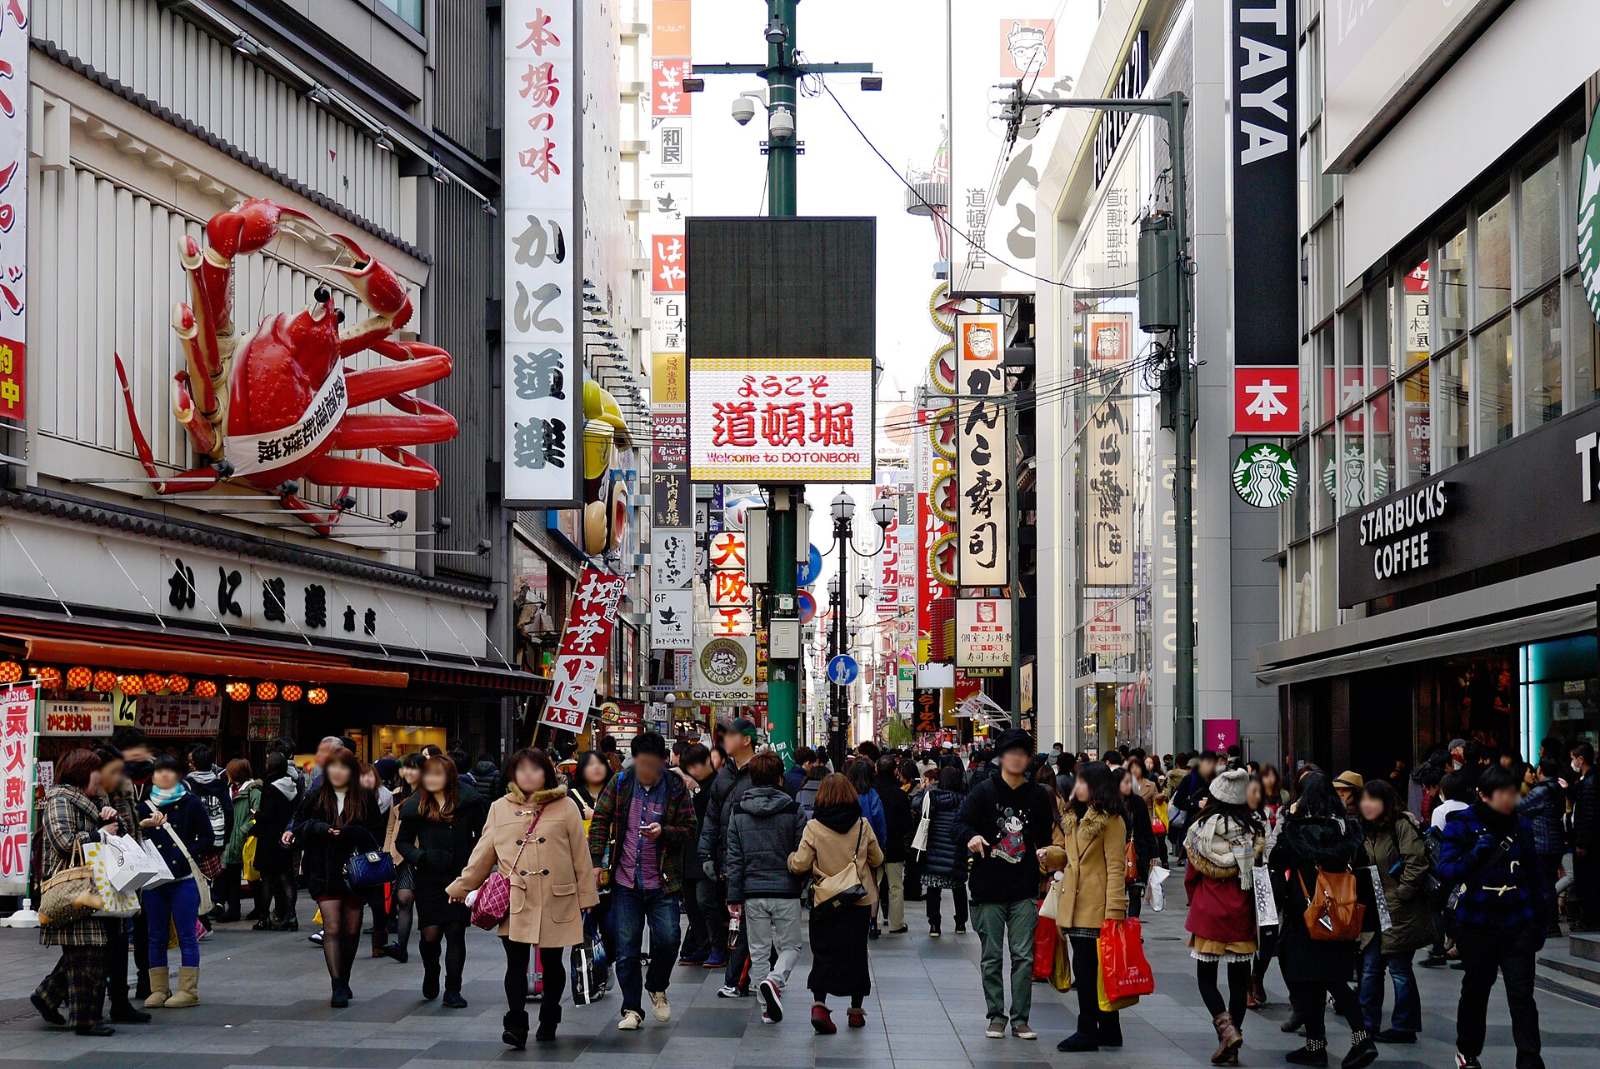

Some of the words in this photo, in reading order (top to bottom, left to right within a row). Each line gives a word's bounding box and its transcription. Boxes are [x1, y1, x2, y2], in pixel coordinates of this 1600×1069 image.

[516, 7, 561, 184] 本場の味
[1239, 0, 1289, 166] TAYA
[663, 129, 680, 162] 和民
[653, 180, 665, 190] 6F
[966, 188, 987, 270] 道頓堀店
[511, 214, 566, 471] かに道楽
[665, 299, 687, 349] 白木屋
[737, 374, 829, 399] ようこそ
[1244, 379, 1288, 422] 本
[711, 401, 855, 448] 道頓堀
[655, 475, 666, 483] 2F
[706, 452, 761, 463] Welcome
[763, 453, 779, 463] to
[781, 452, 860, 463] DOTONBORI
[1575, 431, 1600, 503] T
[1359, 479, 1446, 546] STARBUCKS
[1373, 531, 1430, 581] COFFEE
[168, 558, 327, 629] かに道楽
[654, 593, 667, 603] 6F
[550, 708, 580, 725] 入荷
[693, 691, 722, 699] CAFE
